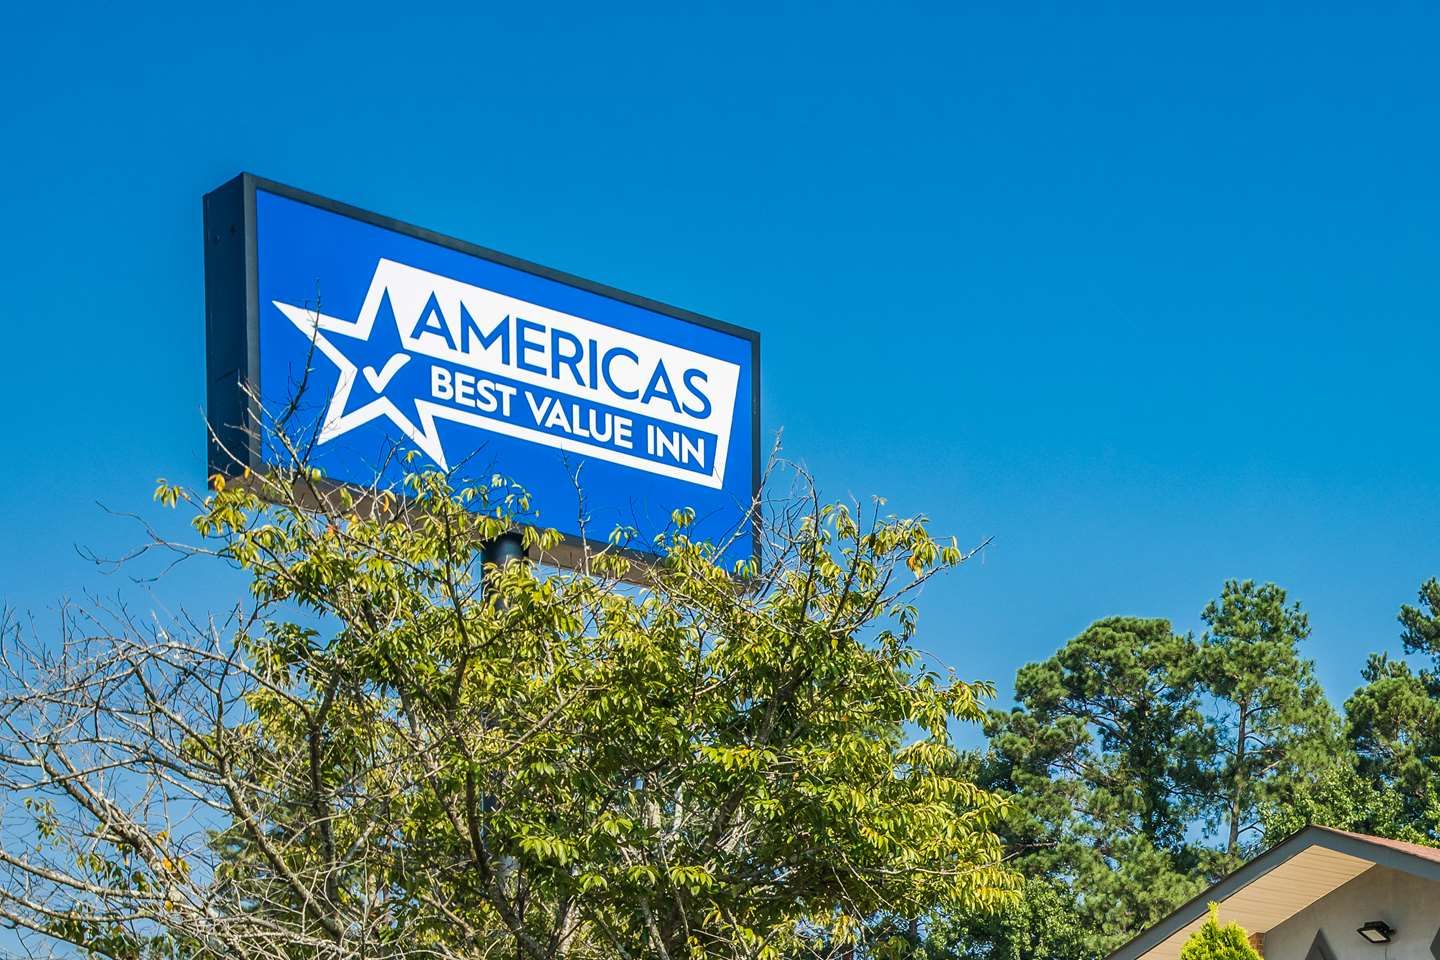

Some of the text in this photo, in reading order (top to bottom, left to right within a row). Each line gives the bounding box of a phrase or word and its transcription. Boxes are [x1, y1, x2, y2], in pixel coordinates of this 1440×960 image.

[410, 290, 712, 420] AMERICAS
[431, 364, 705, 469] BEST VALUE INN
